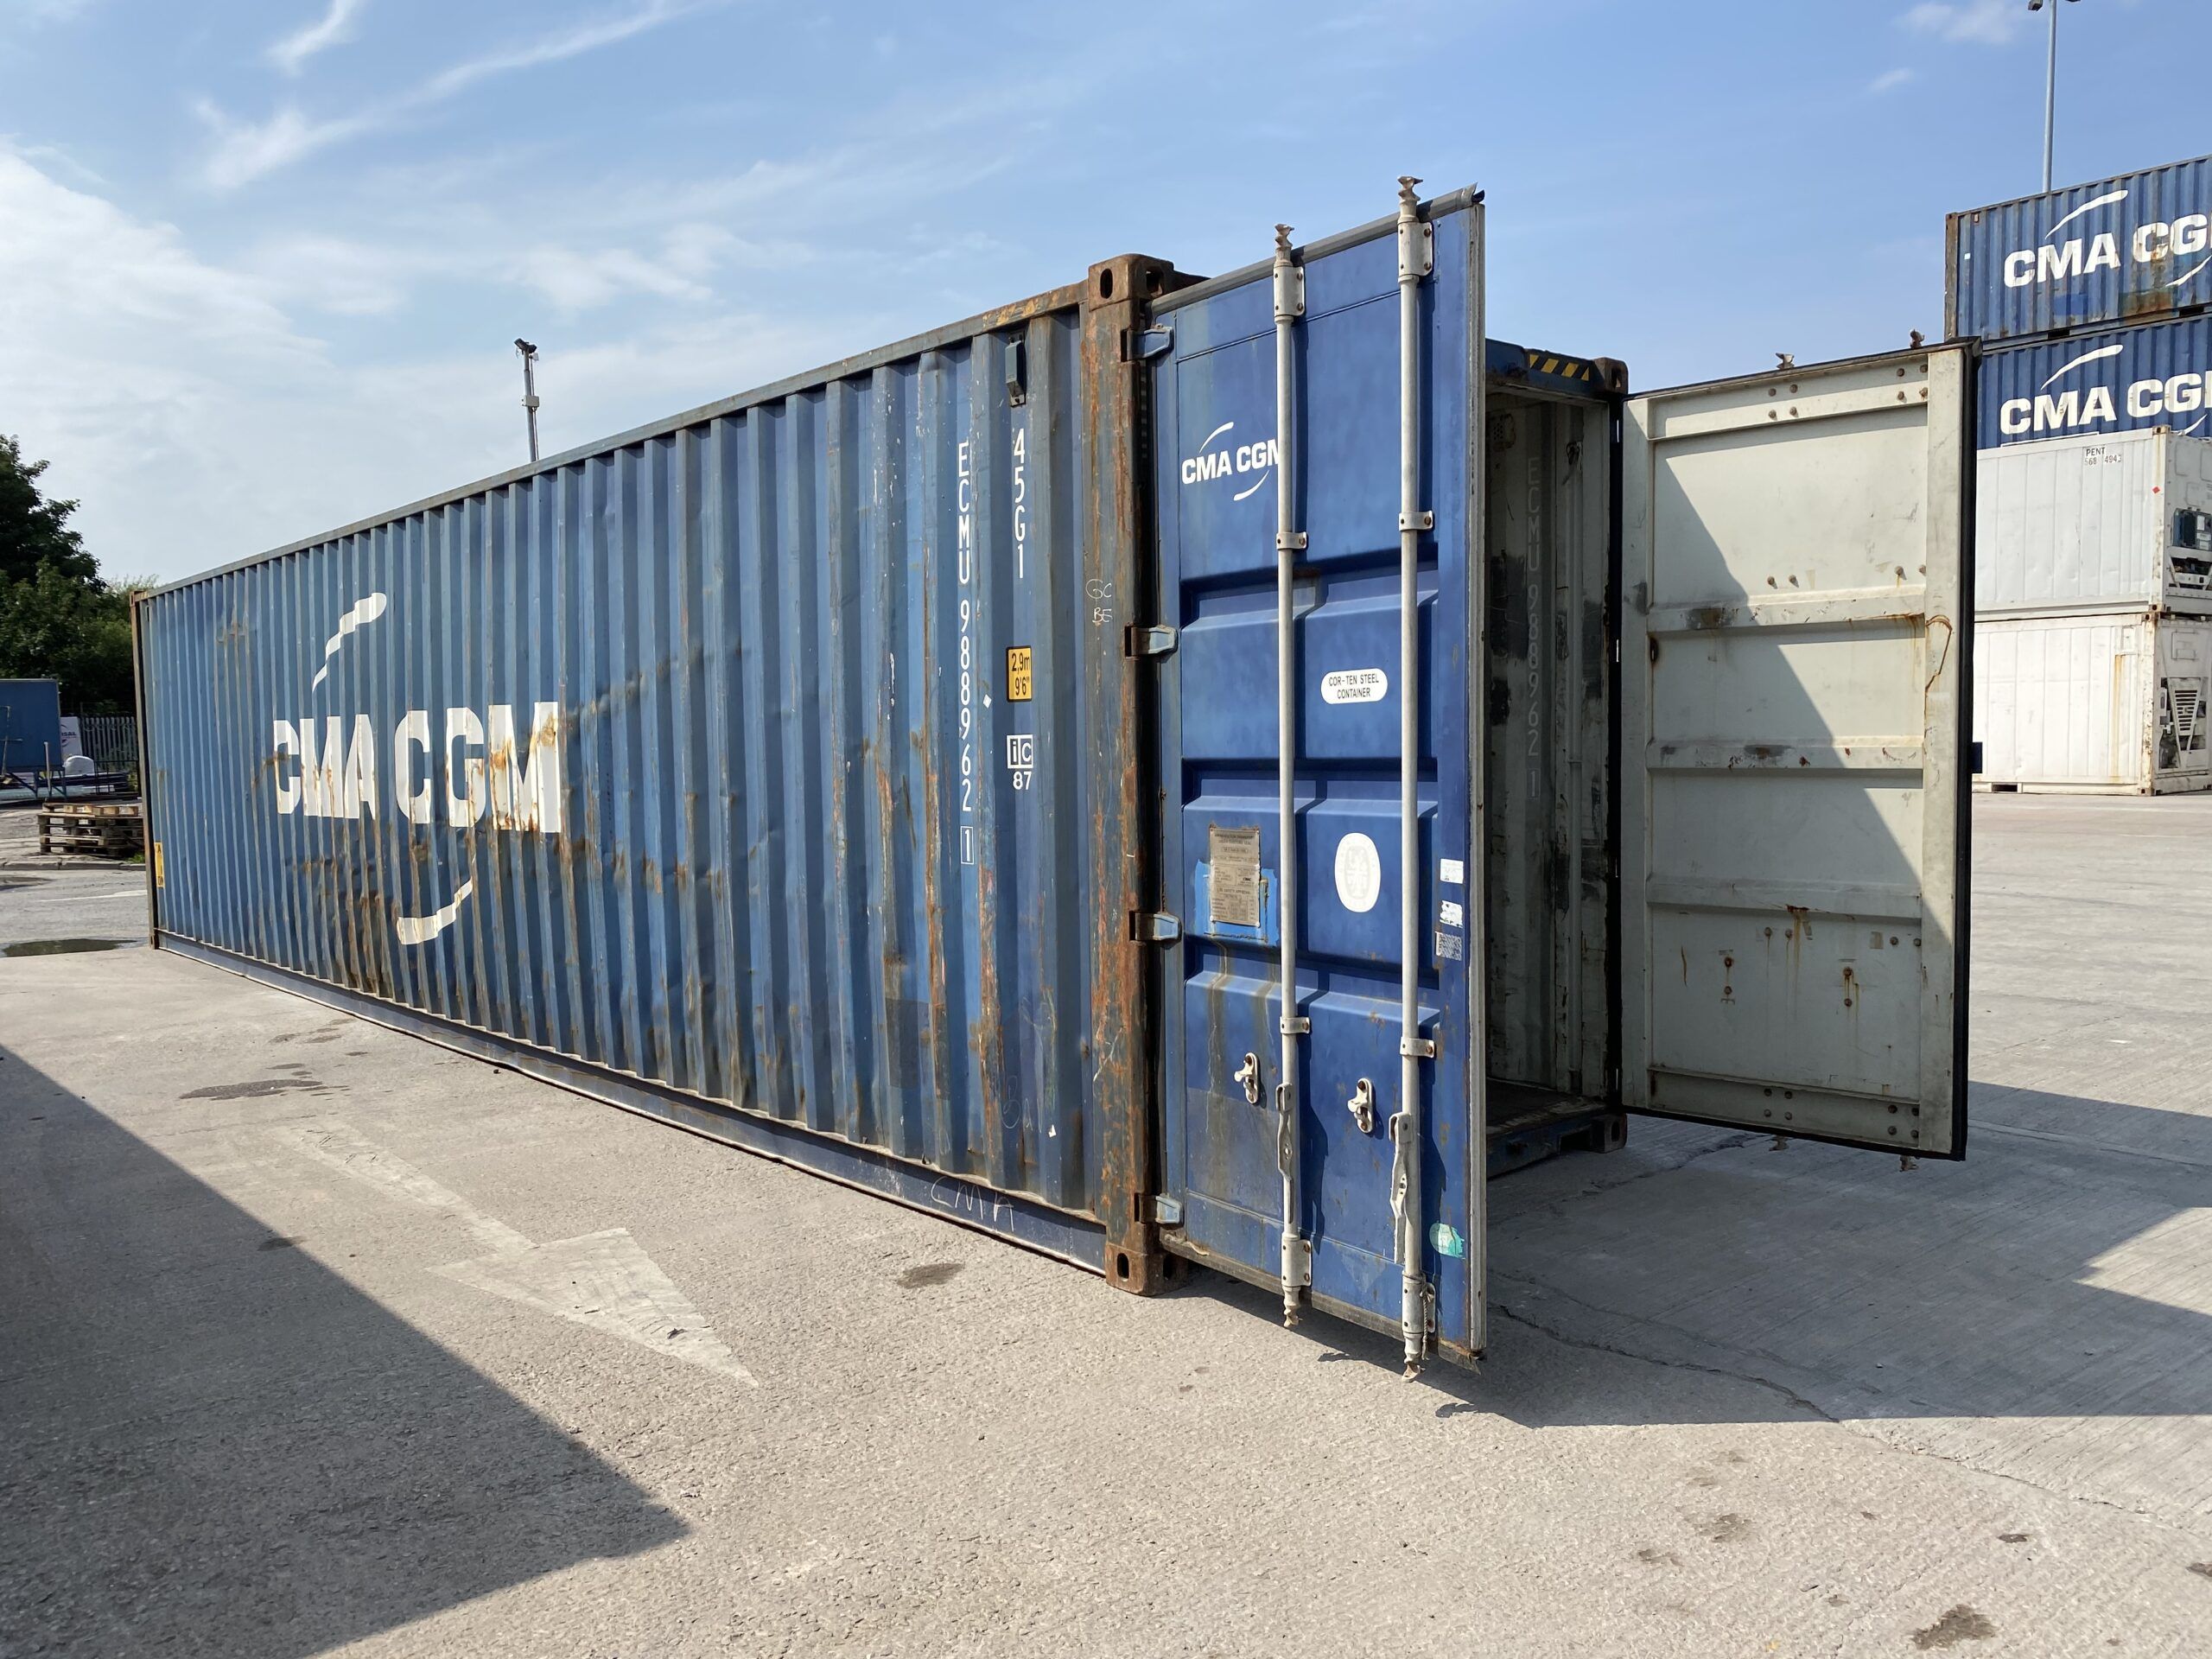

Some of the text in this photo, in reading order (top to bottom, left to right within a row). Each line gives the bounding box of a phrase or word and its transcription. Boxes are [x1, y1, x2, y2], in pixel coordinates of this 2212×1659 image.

[2004, 212, 2212, 288] CMA CG
[1999, 371, 2212, 435] CMA CG
[1181, 450, 1232, 485] CMA
[2086, 447, 2105, 456] PENT
[957, 442, 969, 584] ECMU
[1328, 673, 1379, 687] COR-TEN STEEL
[1337, 687, 1371, 699] CONTAINER
[960, 600, 972, 811] 988962
[273, 701, 563, 834] CMA CGM
[1013, 771, 1033, 791] 87
